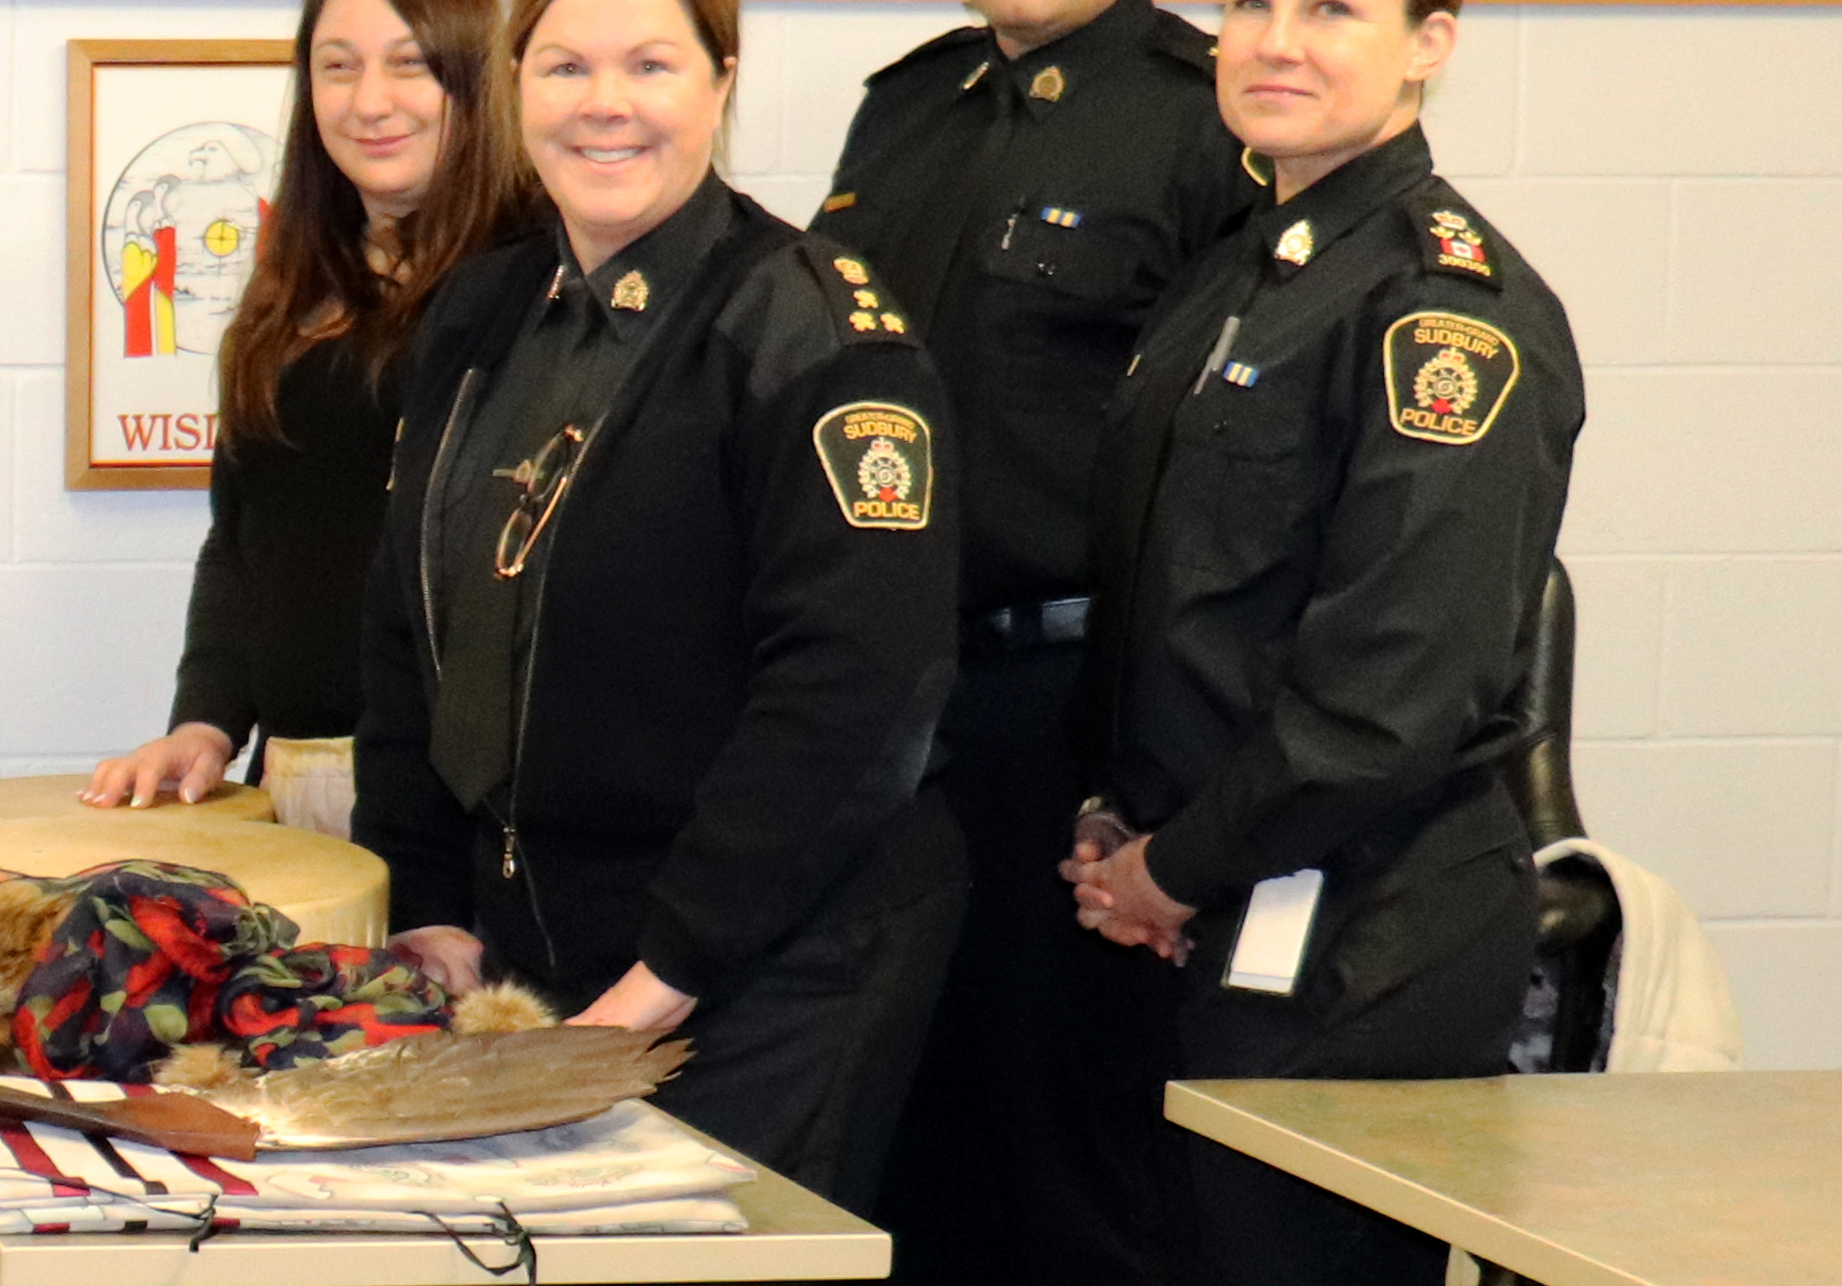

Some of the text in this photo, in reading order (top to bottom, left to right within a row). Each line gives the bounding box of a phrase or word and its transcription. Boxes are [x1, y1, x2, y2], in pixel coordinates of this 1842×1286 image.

[1414, 328, 1499, 360] SUDBURY
[843, 421, 917, 444] SUDBURY
[1400, 408, 1477, 436] POLICE
[853, 501, 920, 520] POLICE
